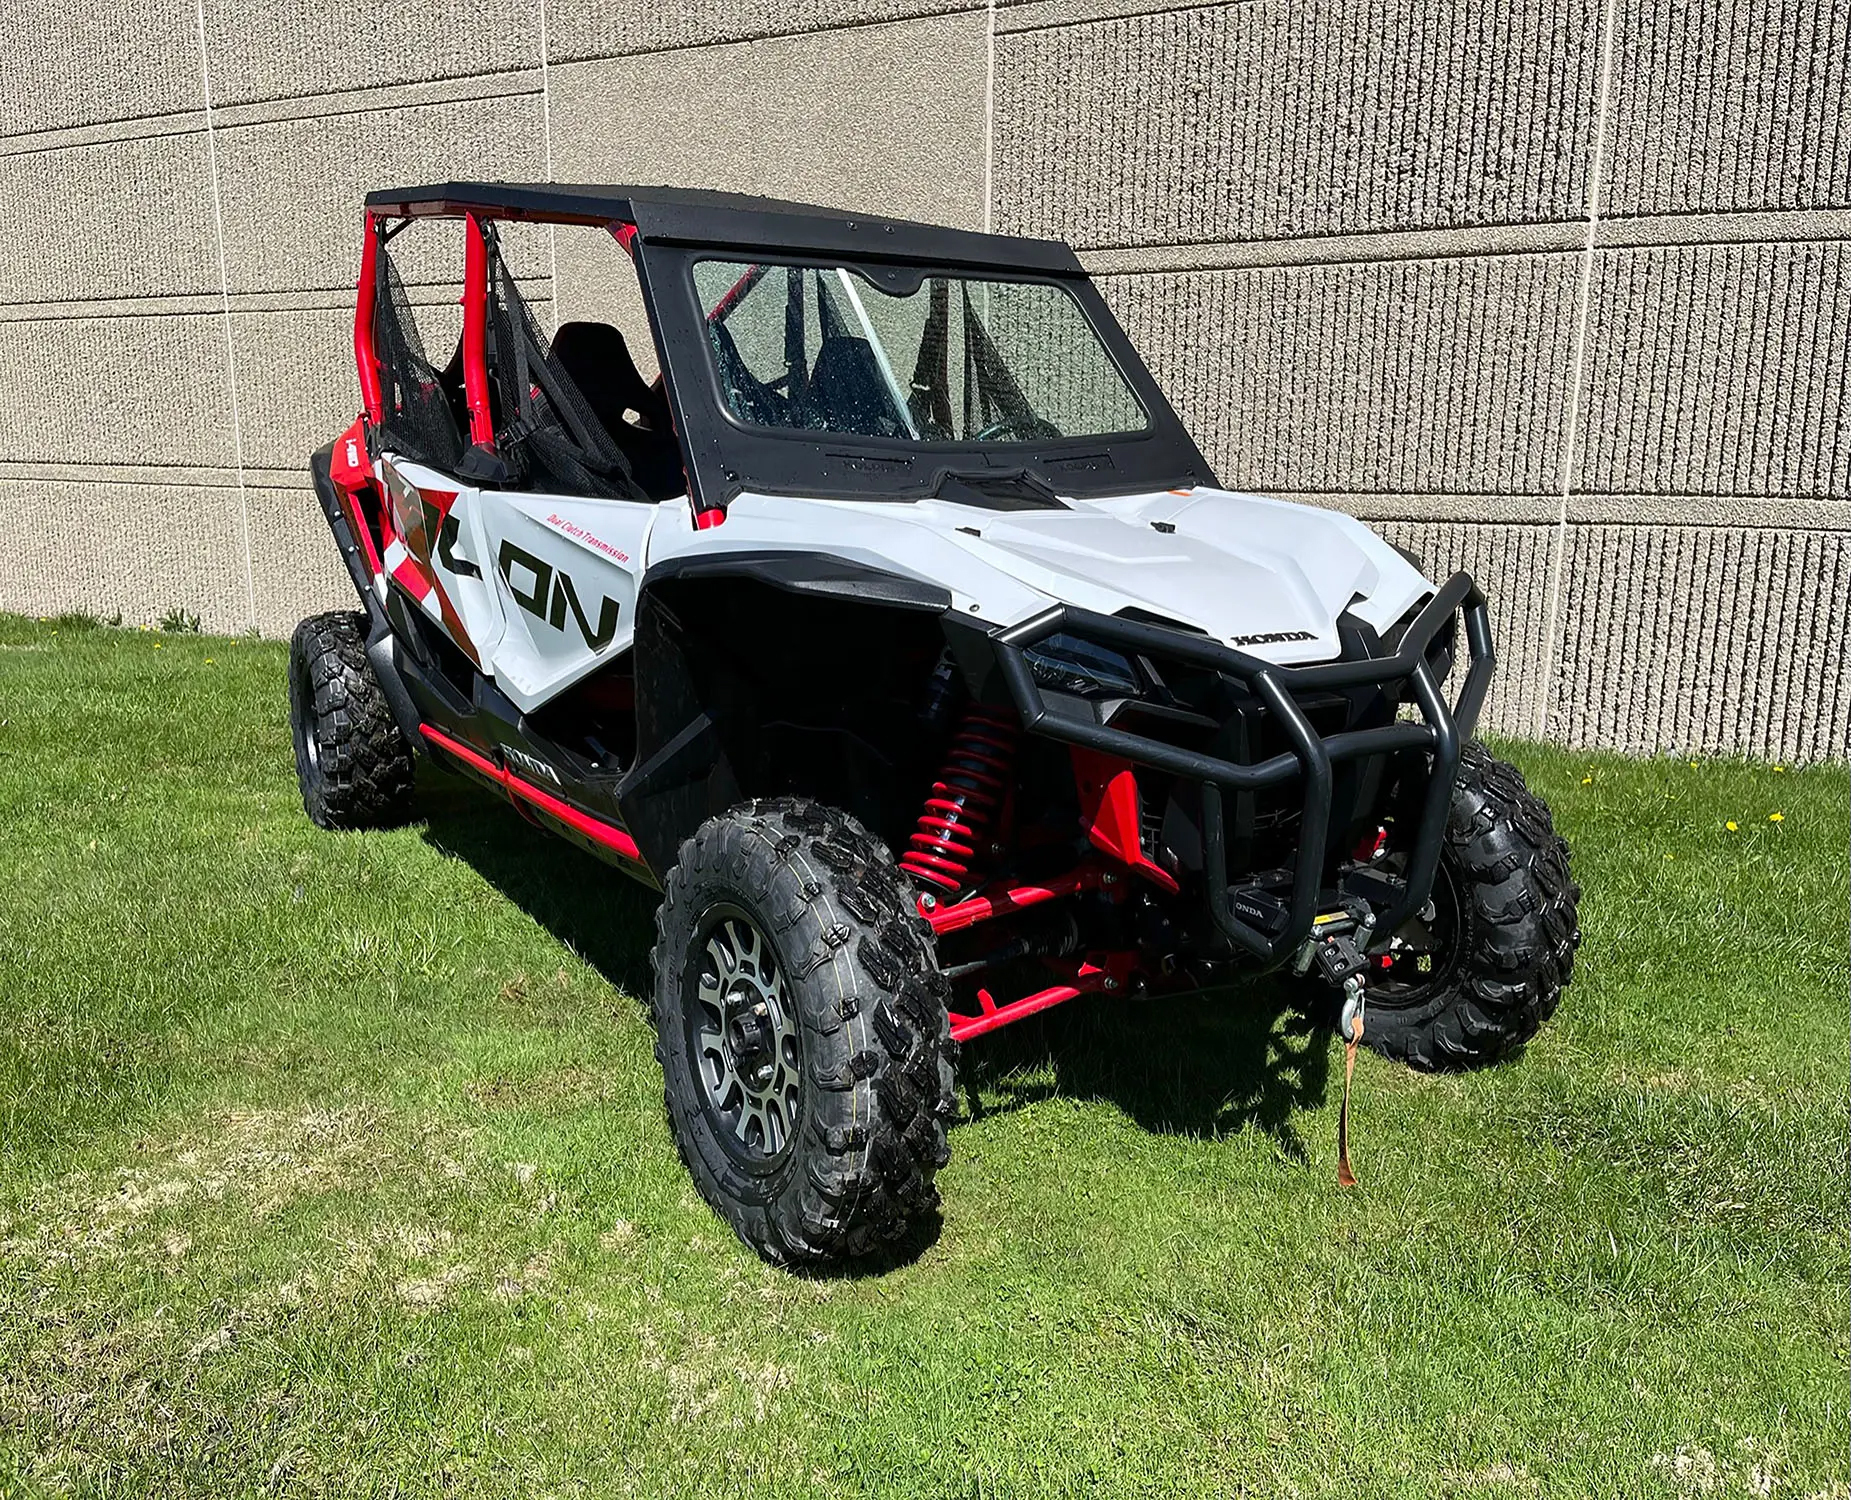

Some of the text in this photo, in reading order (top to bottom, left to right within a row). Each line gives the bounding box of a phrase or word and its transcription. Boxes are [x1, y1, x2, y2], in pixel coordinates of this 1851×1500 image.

[547, 513, 629, 563] Dual Clutch Transmission
[1230, 631, 1319, 646] HONDA
[1235, 902, 1264, 919] ONDA
